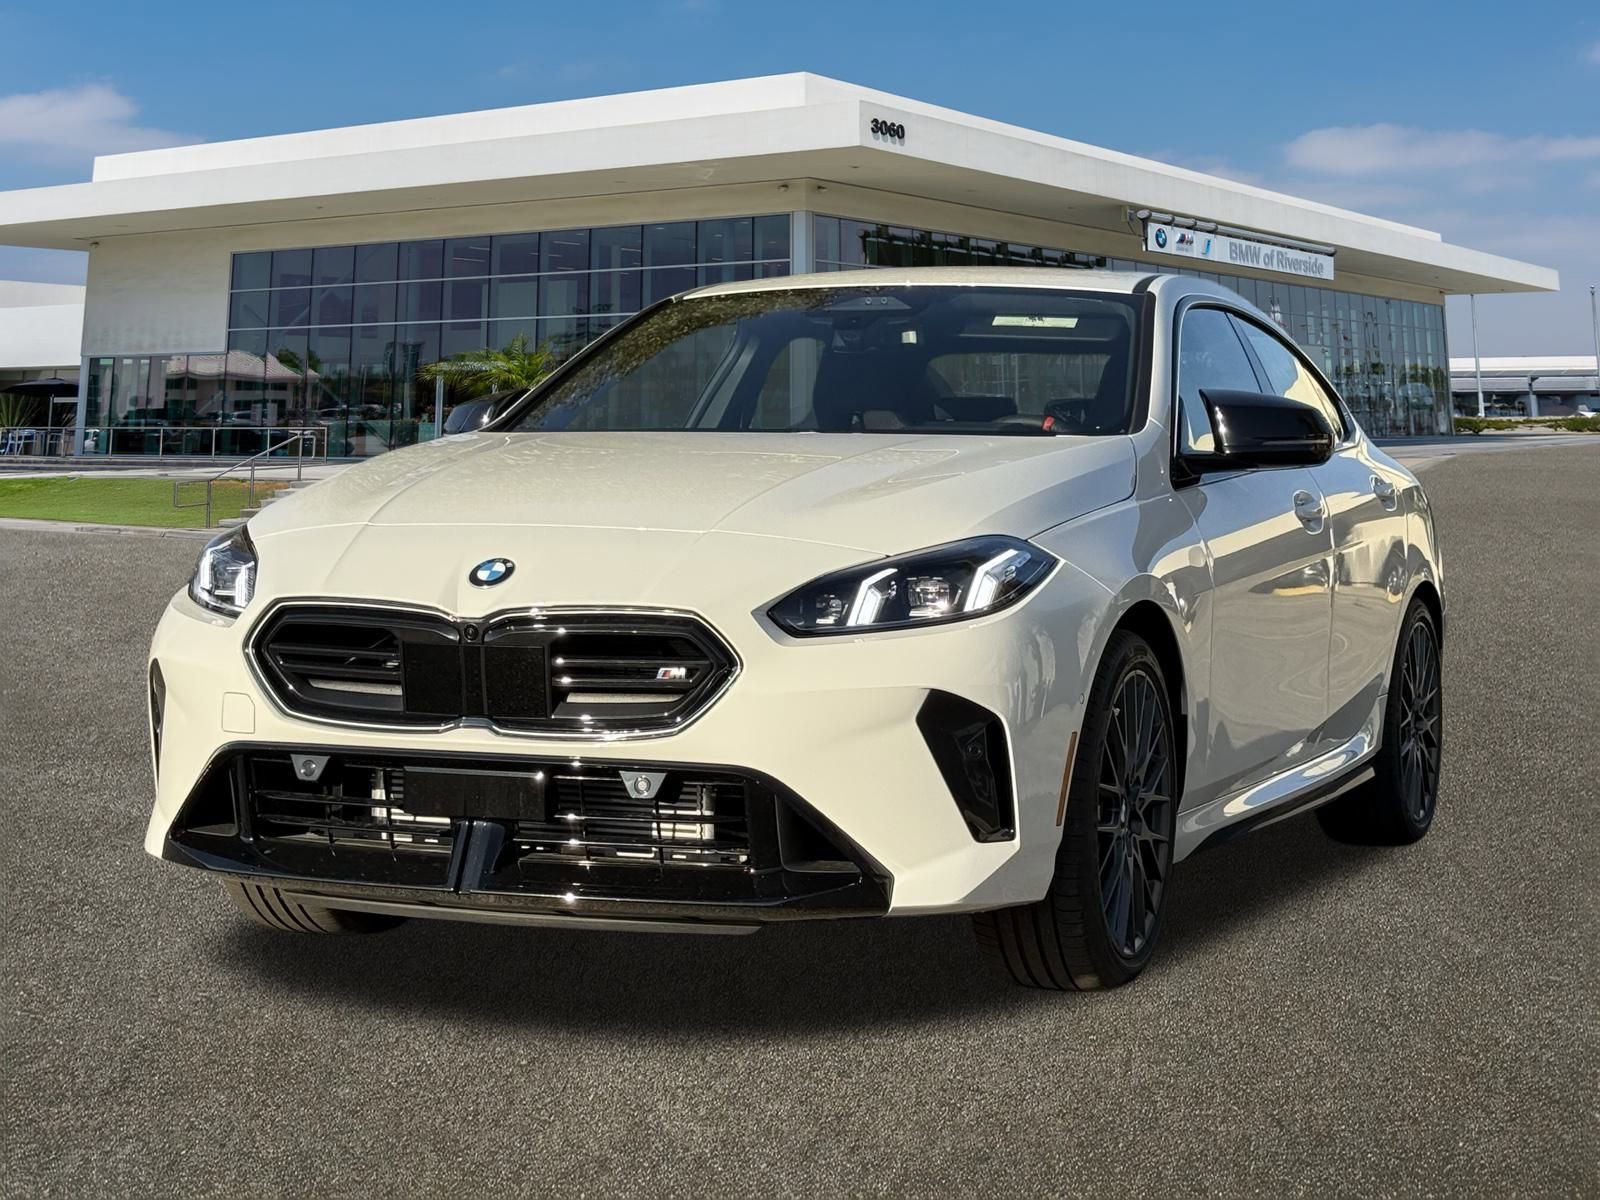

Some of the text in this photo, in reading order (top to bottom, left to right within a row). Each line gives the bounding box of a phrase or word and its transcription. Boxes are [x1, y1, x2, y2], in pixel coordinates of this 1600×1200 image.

[870, 118, 906, 140] 3060
[1229, 241, 1261, 265] BMW
[1263, 249, 1275, 267] of
[1276, 251, 1324, 275] Riverside
